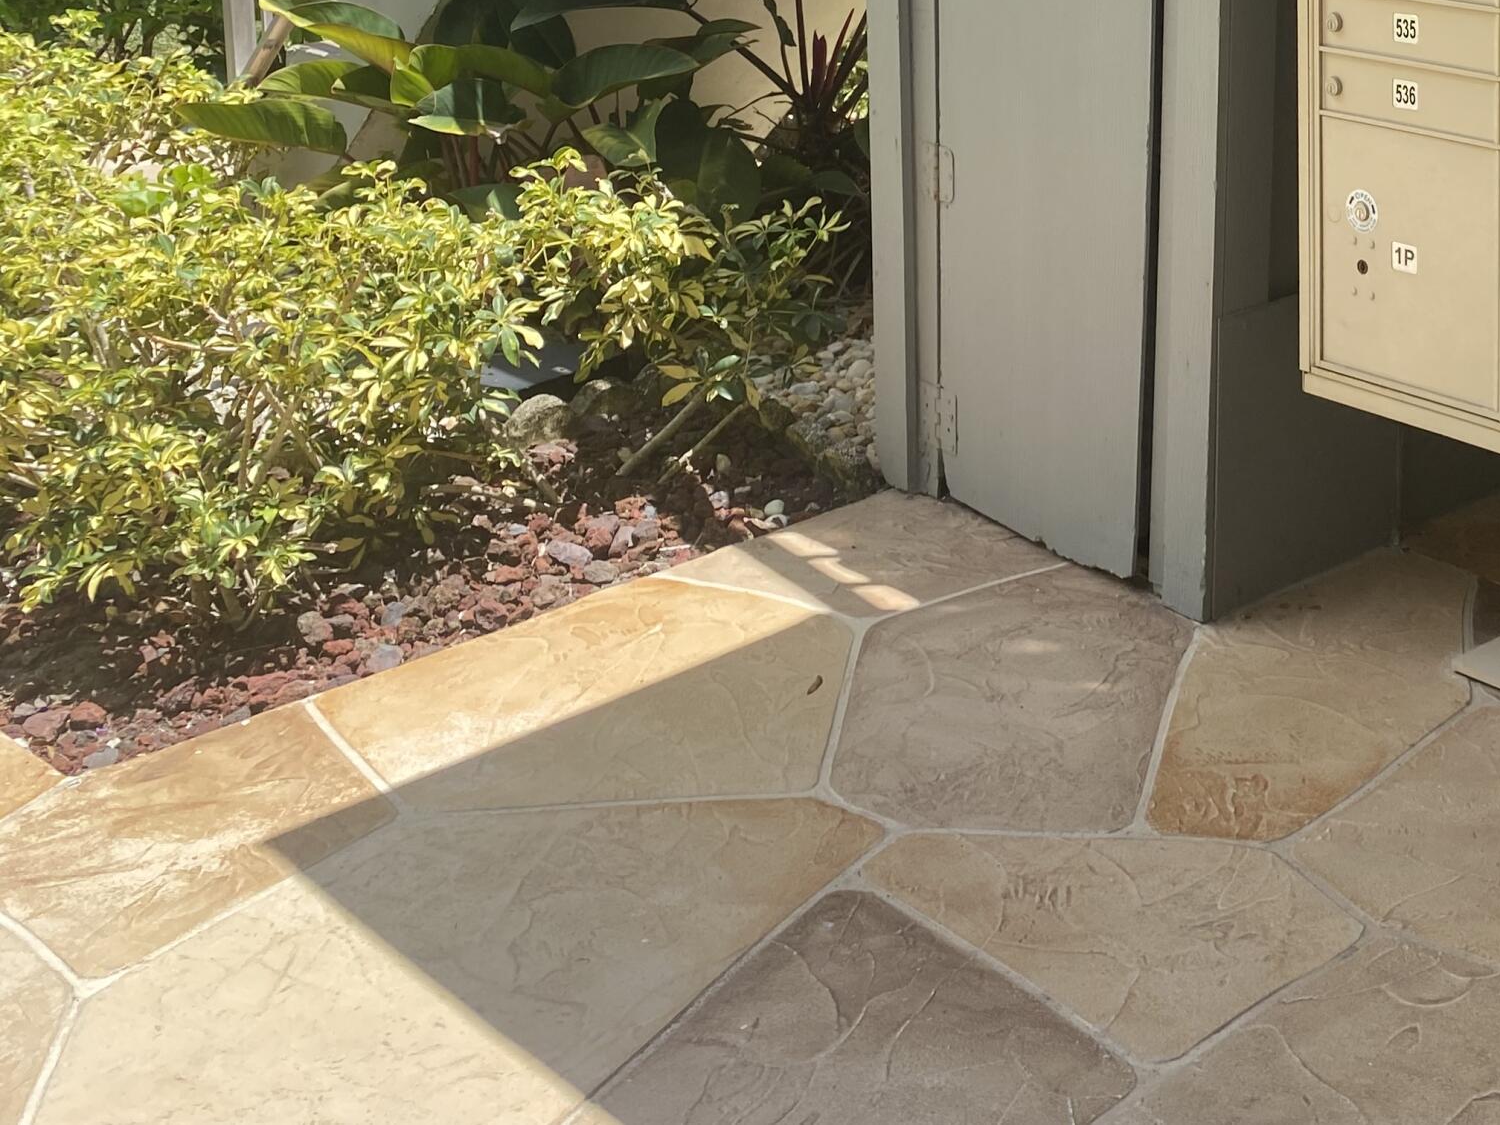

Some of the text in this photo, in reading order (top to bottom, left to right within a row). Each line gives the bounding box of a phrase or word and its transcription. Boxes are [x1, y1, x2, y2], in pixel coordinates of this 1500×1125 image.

[1396, 18, 1417, 39] 535
[1395, 84, 1416, 106] 536
[1354, 191, 1372, 204] OPEN
[1394, 246, 1415, 267] 1P
